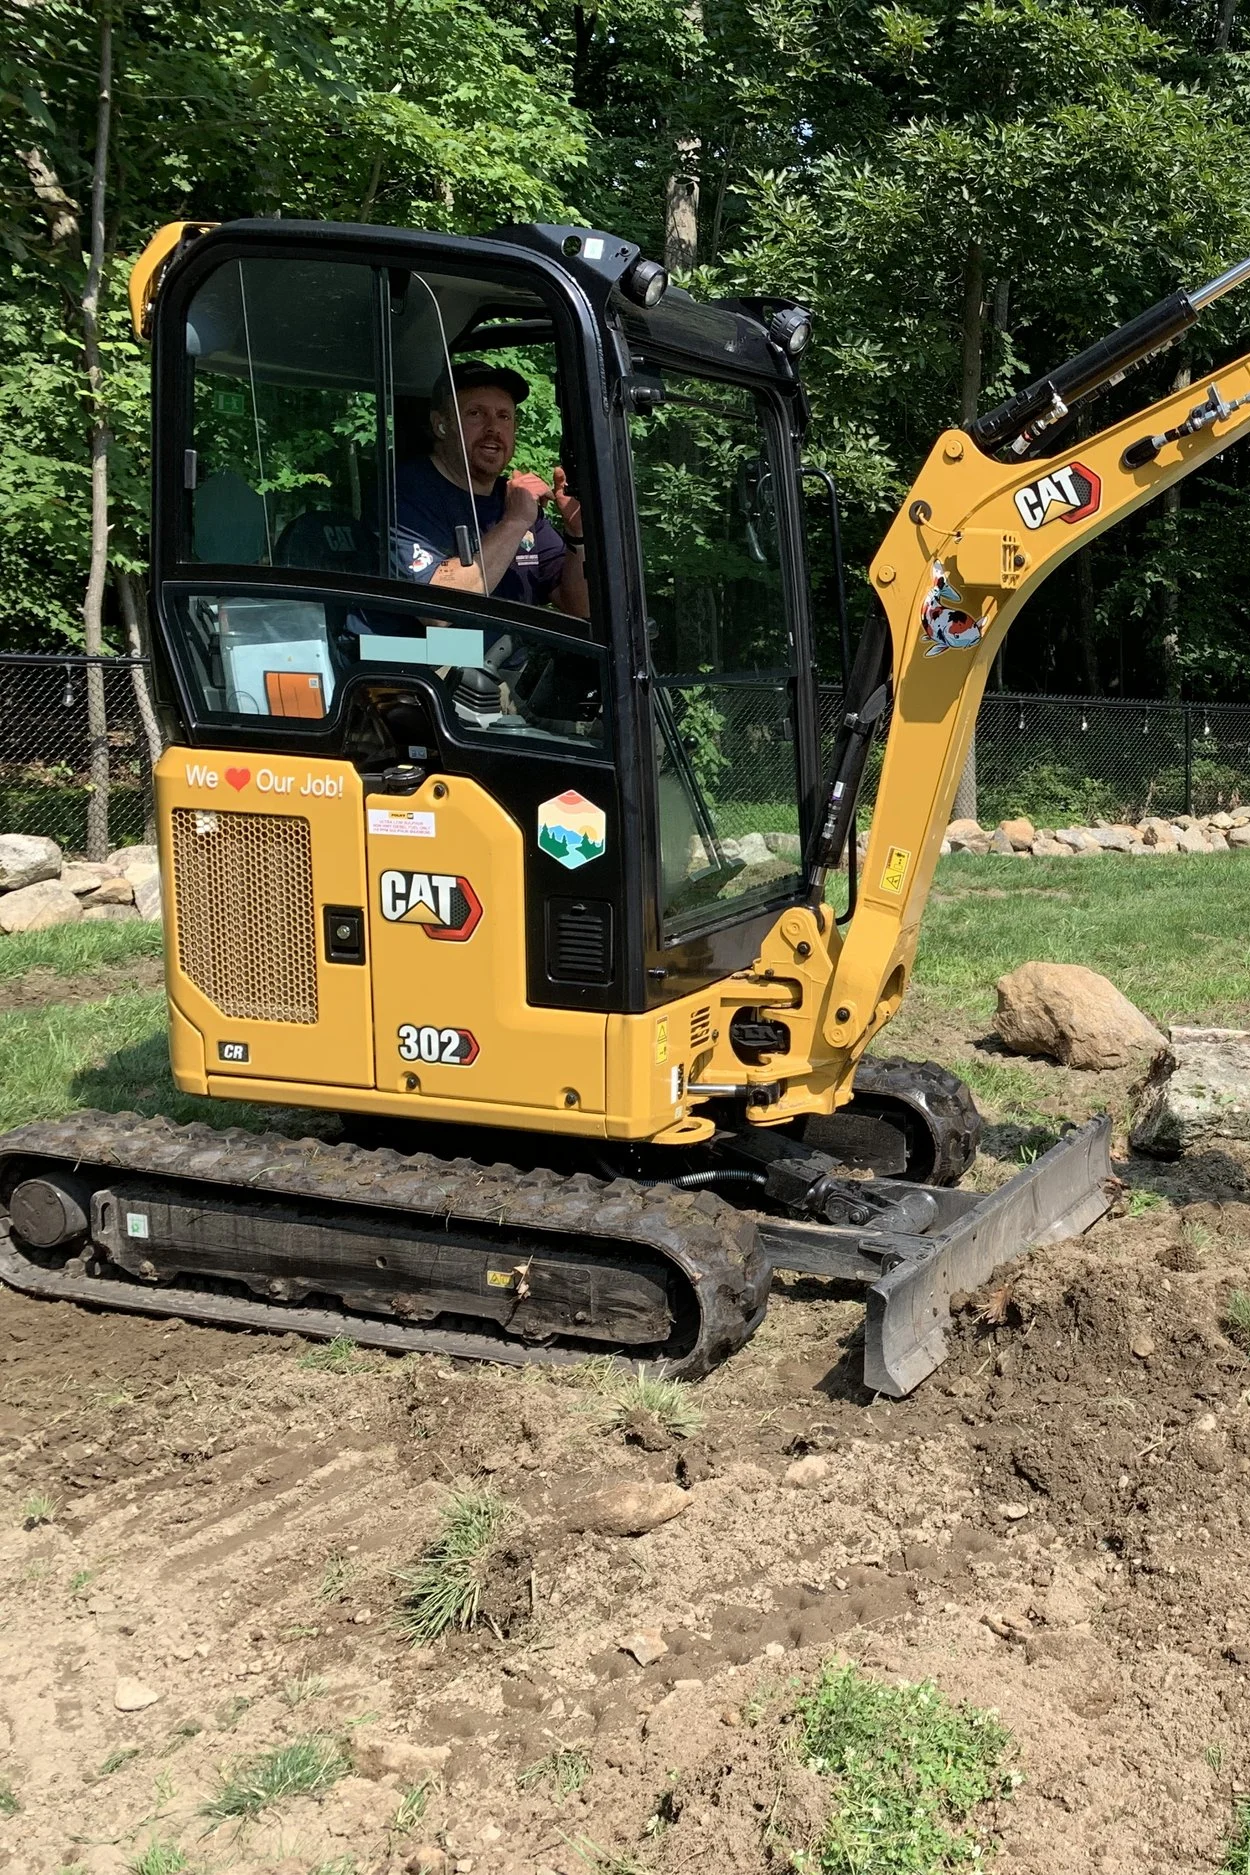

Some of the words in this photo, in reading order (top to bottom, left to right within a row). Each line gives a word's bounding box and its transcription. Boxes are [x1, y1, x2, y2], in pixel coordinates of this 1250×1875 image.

[1014, 465, 1081, 529] CAT
[186, 764, 219, 788] We
[256, 768, 295, 793] Our
[300, 773, 344, 798] Job!
[381, 870, 457, 926] CAT
[224, 1044, 244, 1060] CR
[398, 1024, 460, 1063] 302
